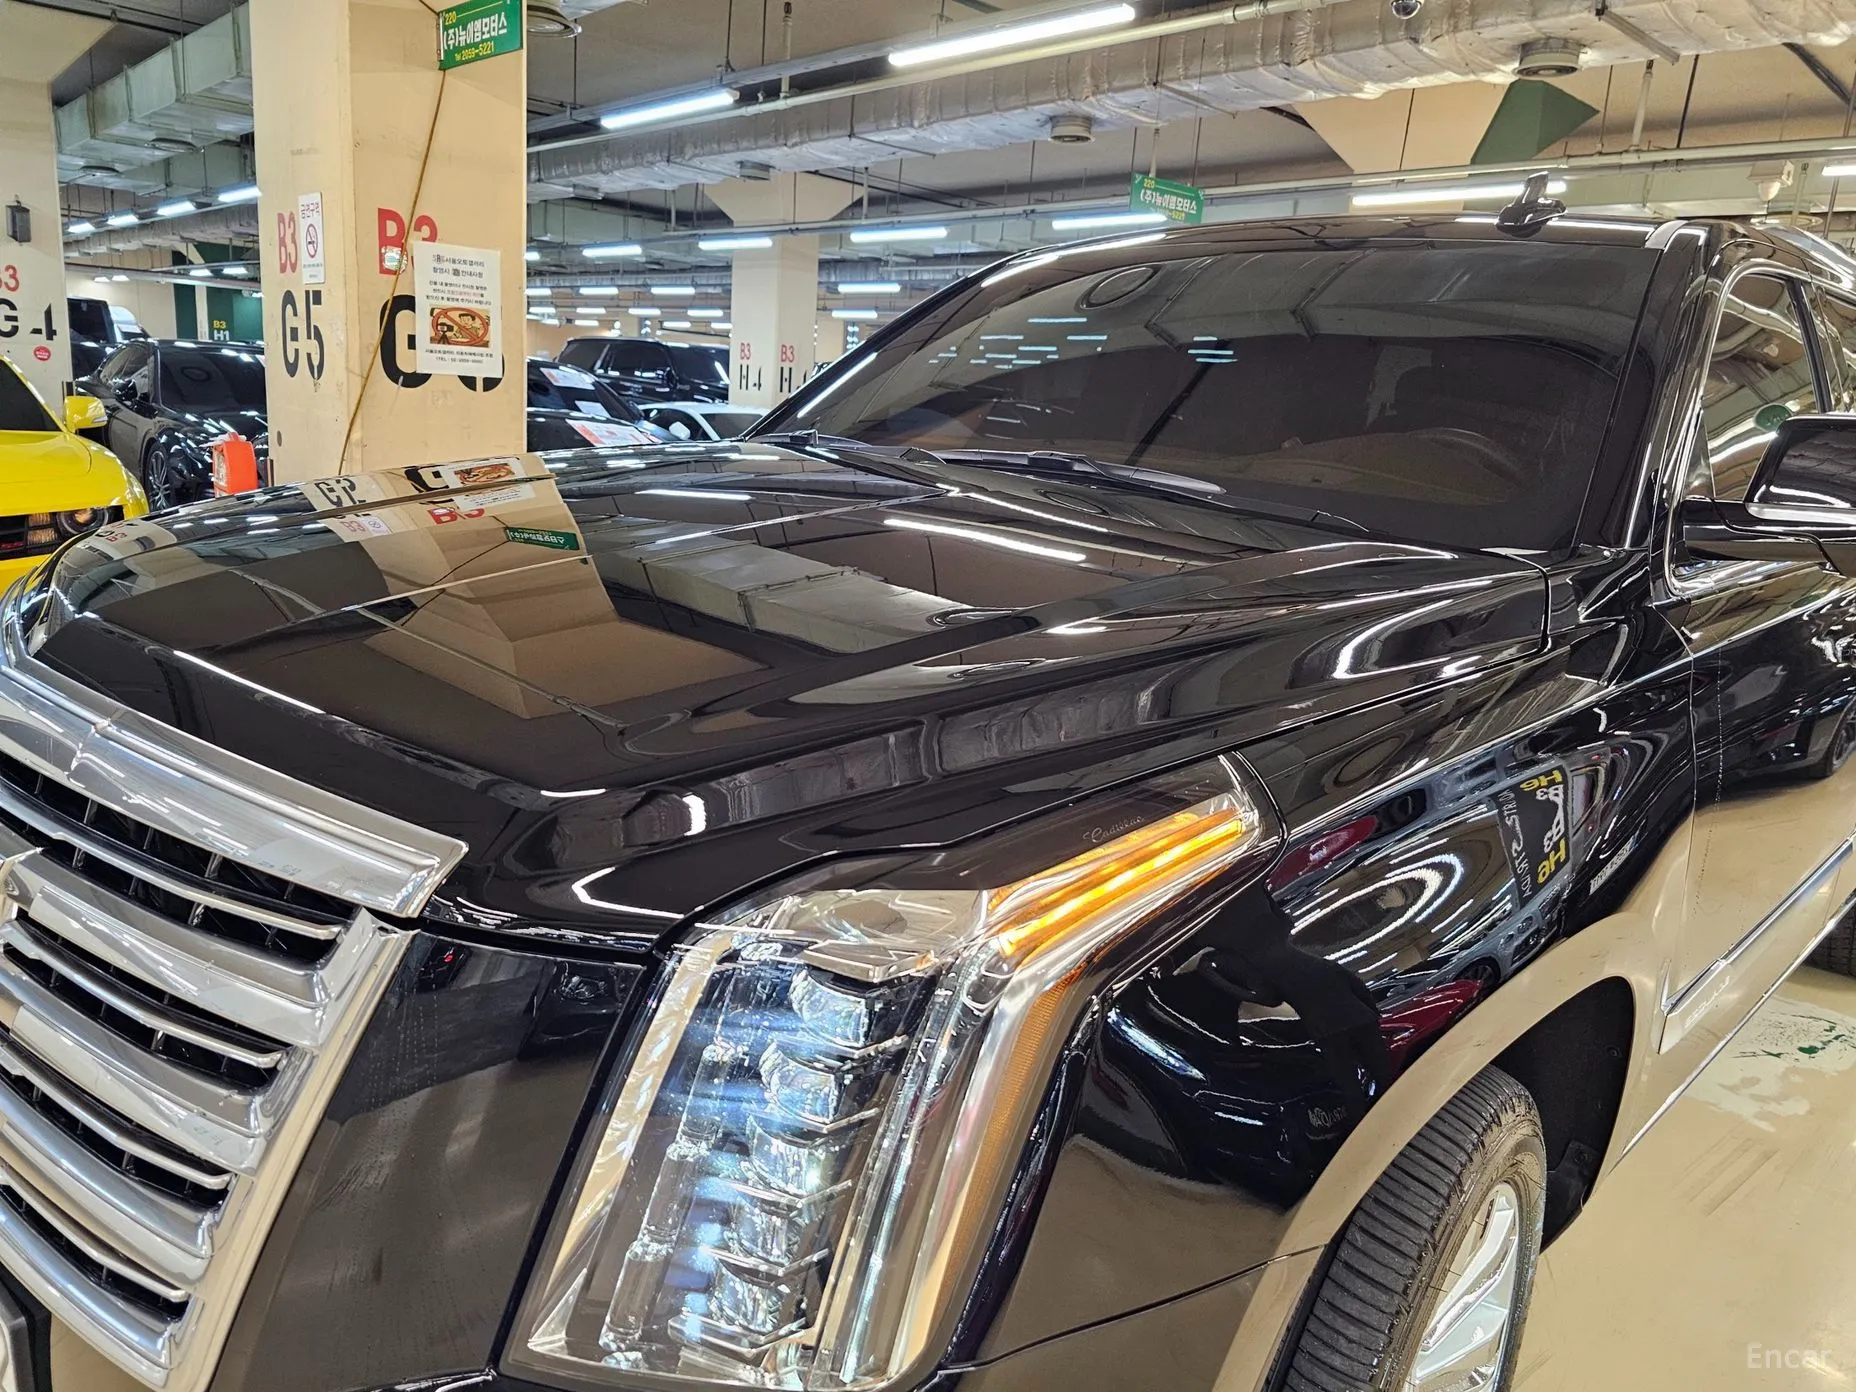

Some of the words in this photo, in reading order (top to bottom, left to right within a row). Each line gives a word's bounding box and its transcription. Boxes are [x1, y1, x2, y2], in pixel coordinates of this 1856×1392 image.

[444, 11, 457, 25] 220
[300, 201, 320, 219] 금연구역
[277, 211, 299, 274] B3
[0, 264, 20, 292] 3
[213, 320, 227, 329] B3
[213, 330, 230, 341] H1
[281, 289, 325, 381] G5
[740, 342, 751, 360] B3
[780, 344, 795, 363] B3
[1082, 815, 1145, 843] Cadillac
